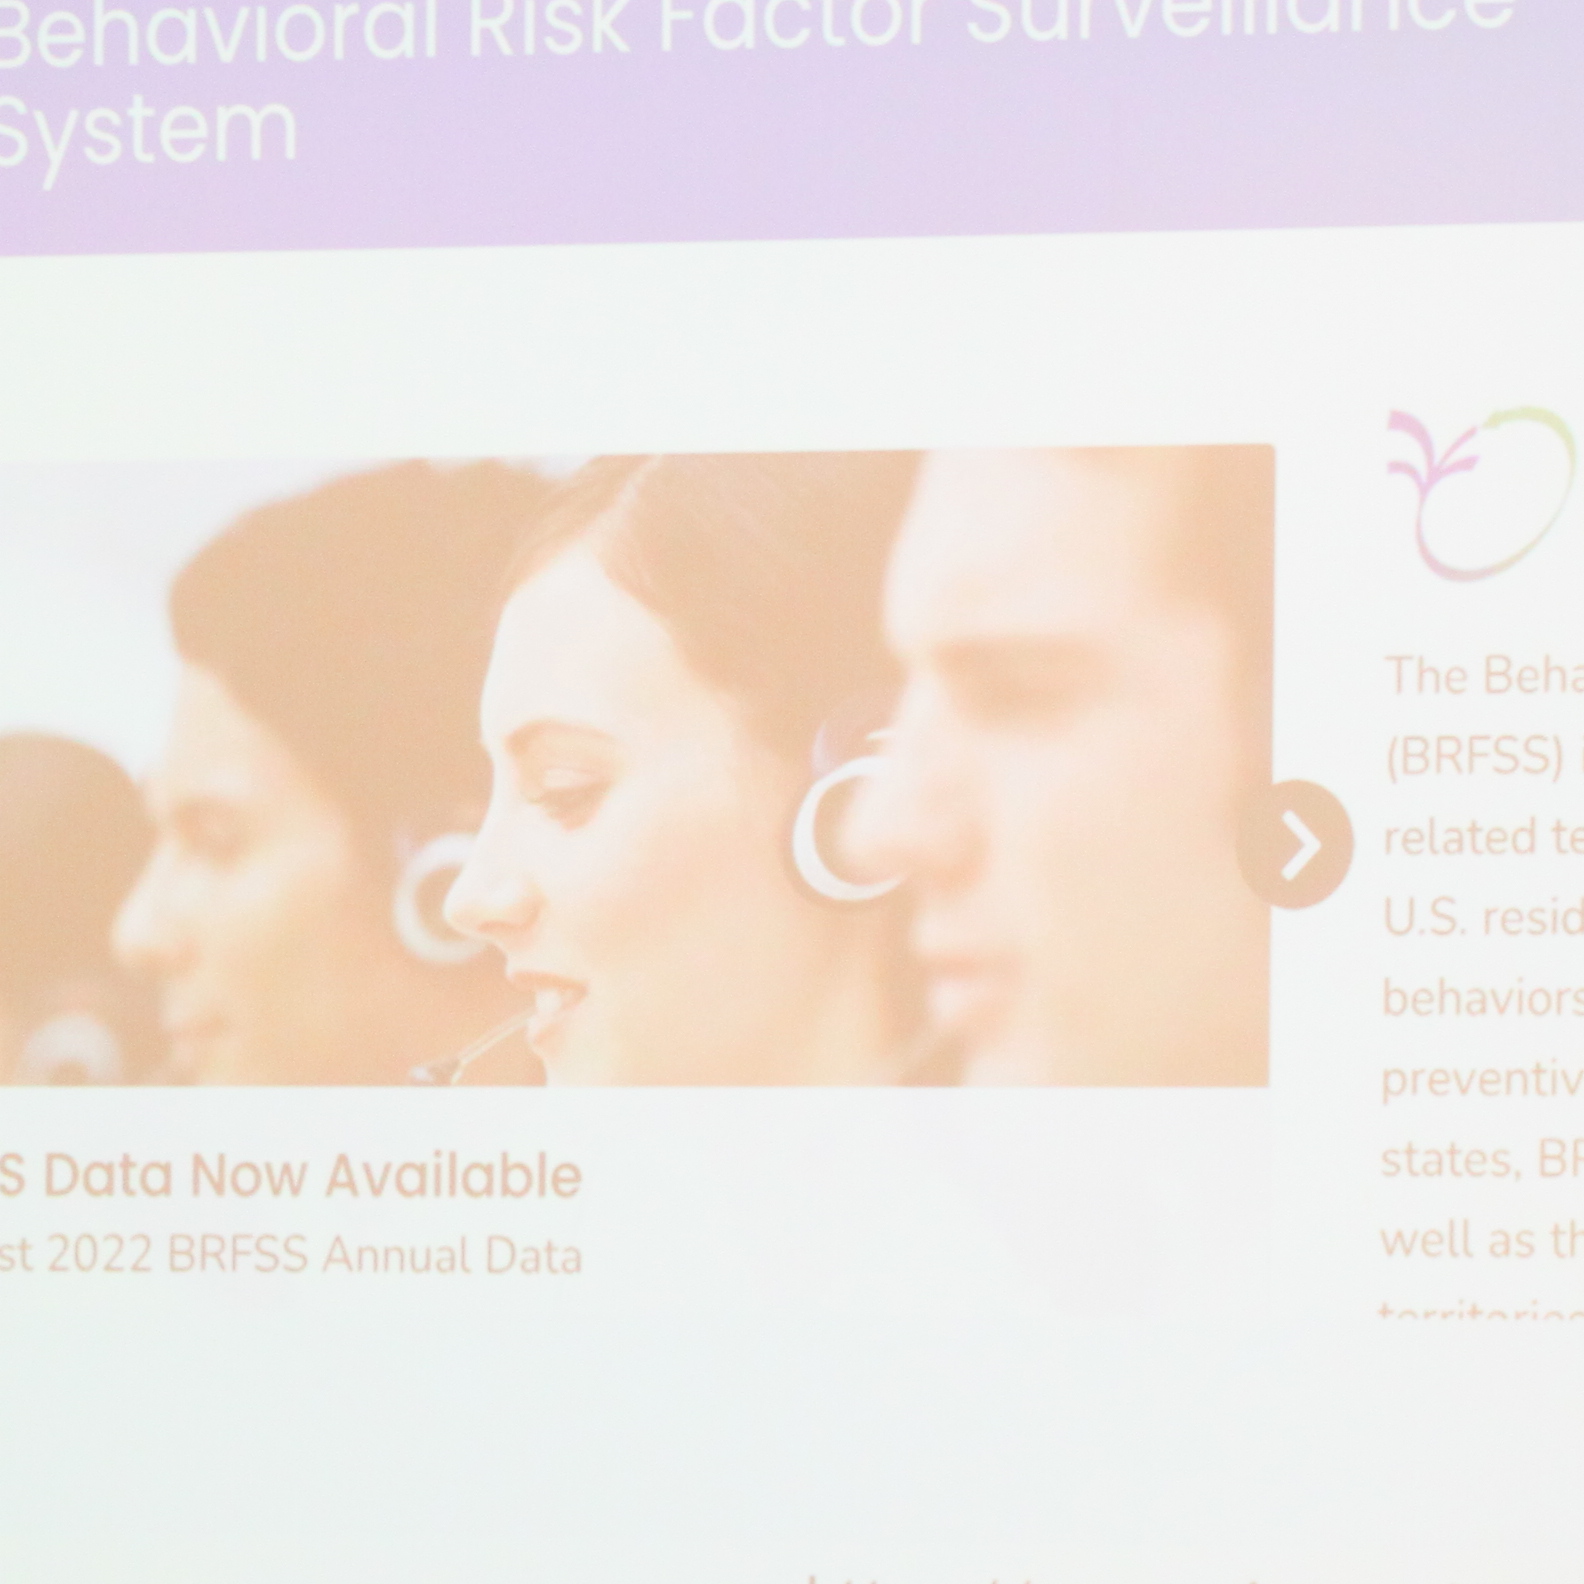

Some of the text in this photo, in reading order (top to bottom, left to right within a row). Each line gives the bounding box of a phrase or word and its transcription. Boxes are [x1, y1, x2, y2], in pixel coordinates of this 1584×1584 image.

[0, 0, 436, 68] Behavioral
[471, 0, 630, 56] Risk
[662, 0, 924, 51] Factor
[0, 94, 296, 190] System
[1384, 654, 1467, 695] The
[1387, 734, 1563, 783] (BRFSS)
[1384, 816, 1536, 854] related
[1384, 895, 1465, 937] U.S.
[45, 1152, 172, 1197] Data
[192, 1153, 307, 1198] Now
[326, 1150, 582, 1198] Available
[1381, 1142, 1521, 1180] states,
[48, 1233, 151, 1273] 2022
[169, 1233, 308, 1274] BRFSS
[322, 1235, 472, 1275] Annual
[486, 1235, 582, 1275] Data
[1379, 1219, 1473, 1258] well
[1489, 1229, 1535, 1258] as
